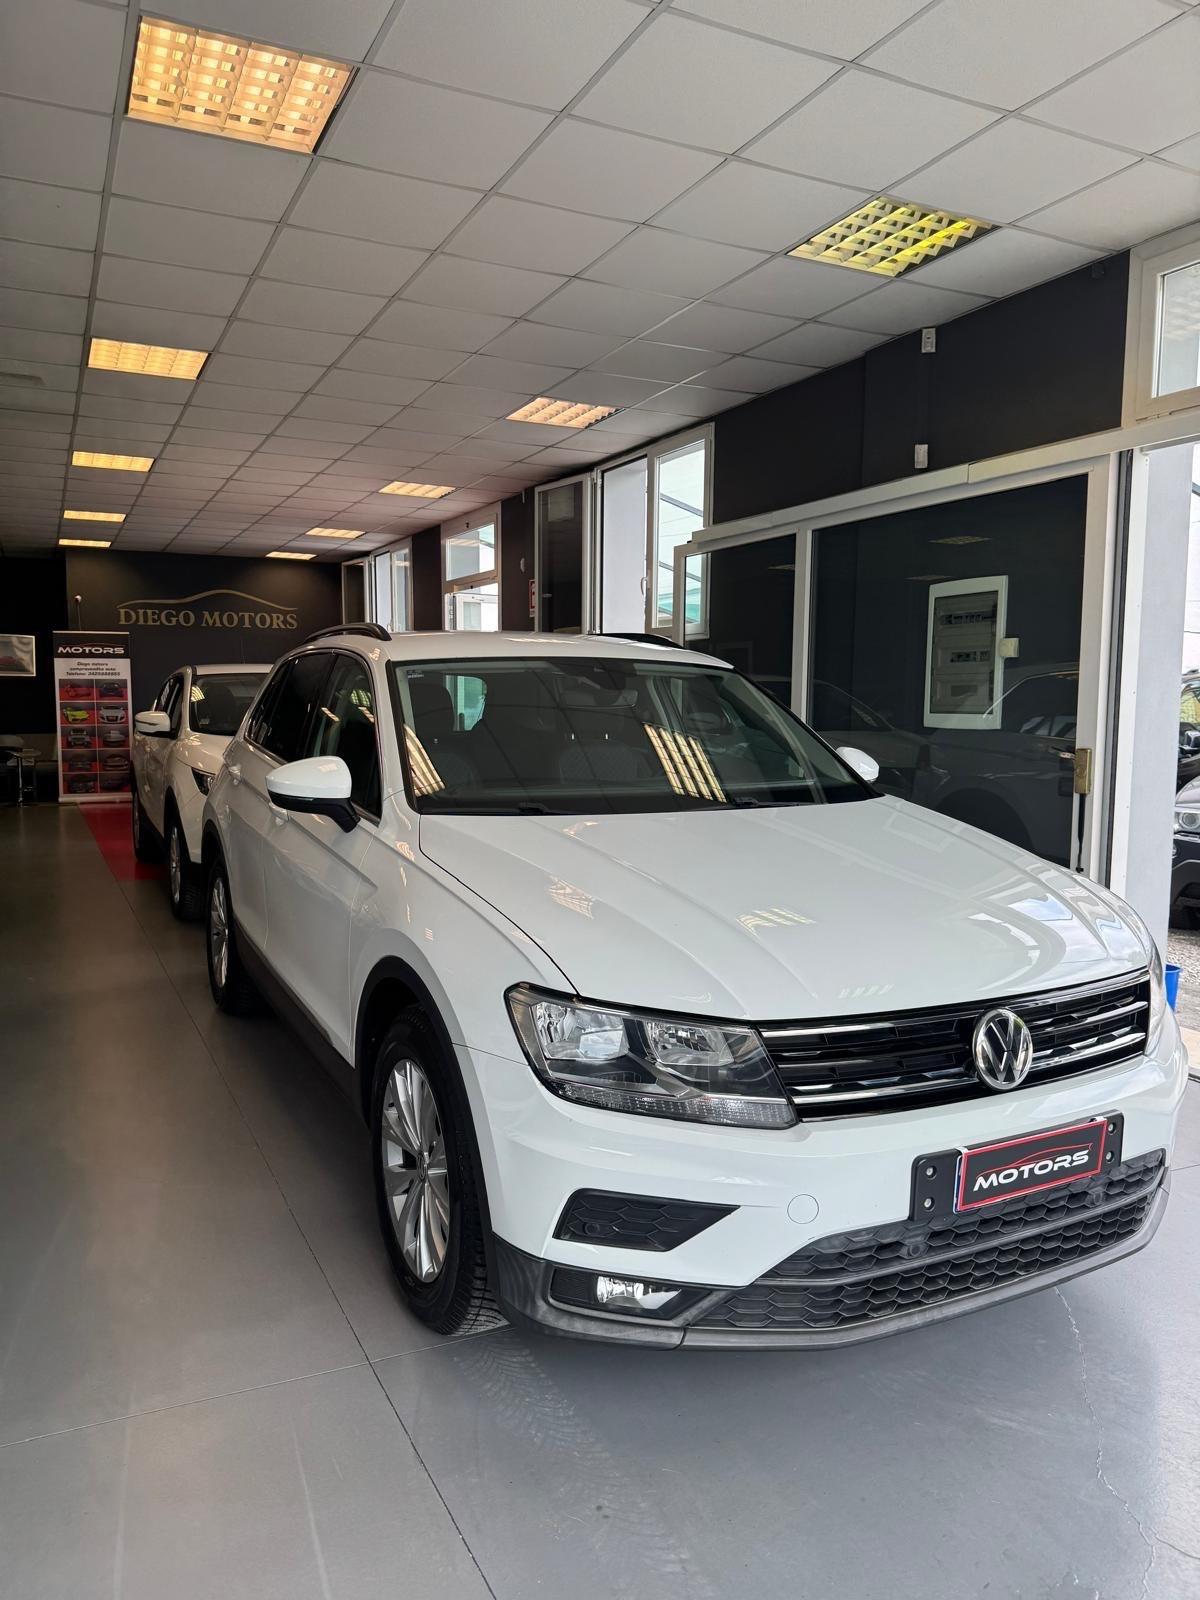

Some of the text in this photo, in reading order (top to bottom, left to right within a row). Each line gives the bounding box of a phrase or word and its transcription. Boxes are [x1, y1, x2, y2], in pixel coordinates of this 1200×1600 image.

[118, 608, 298, 630] DIEGO MOTORS
[57, 646, 125, 654] MOTORS
[973, 1149, 1090, 1192] MOTORS
